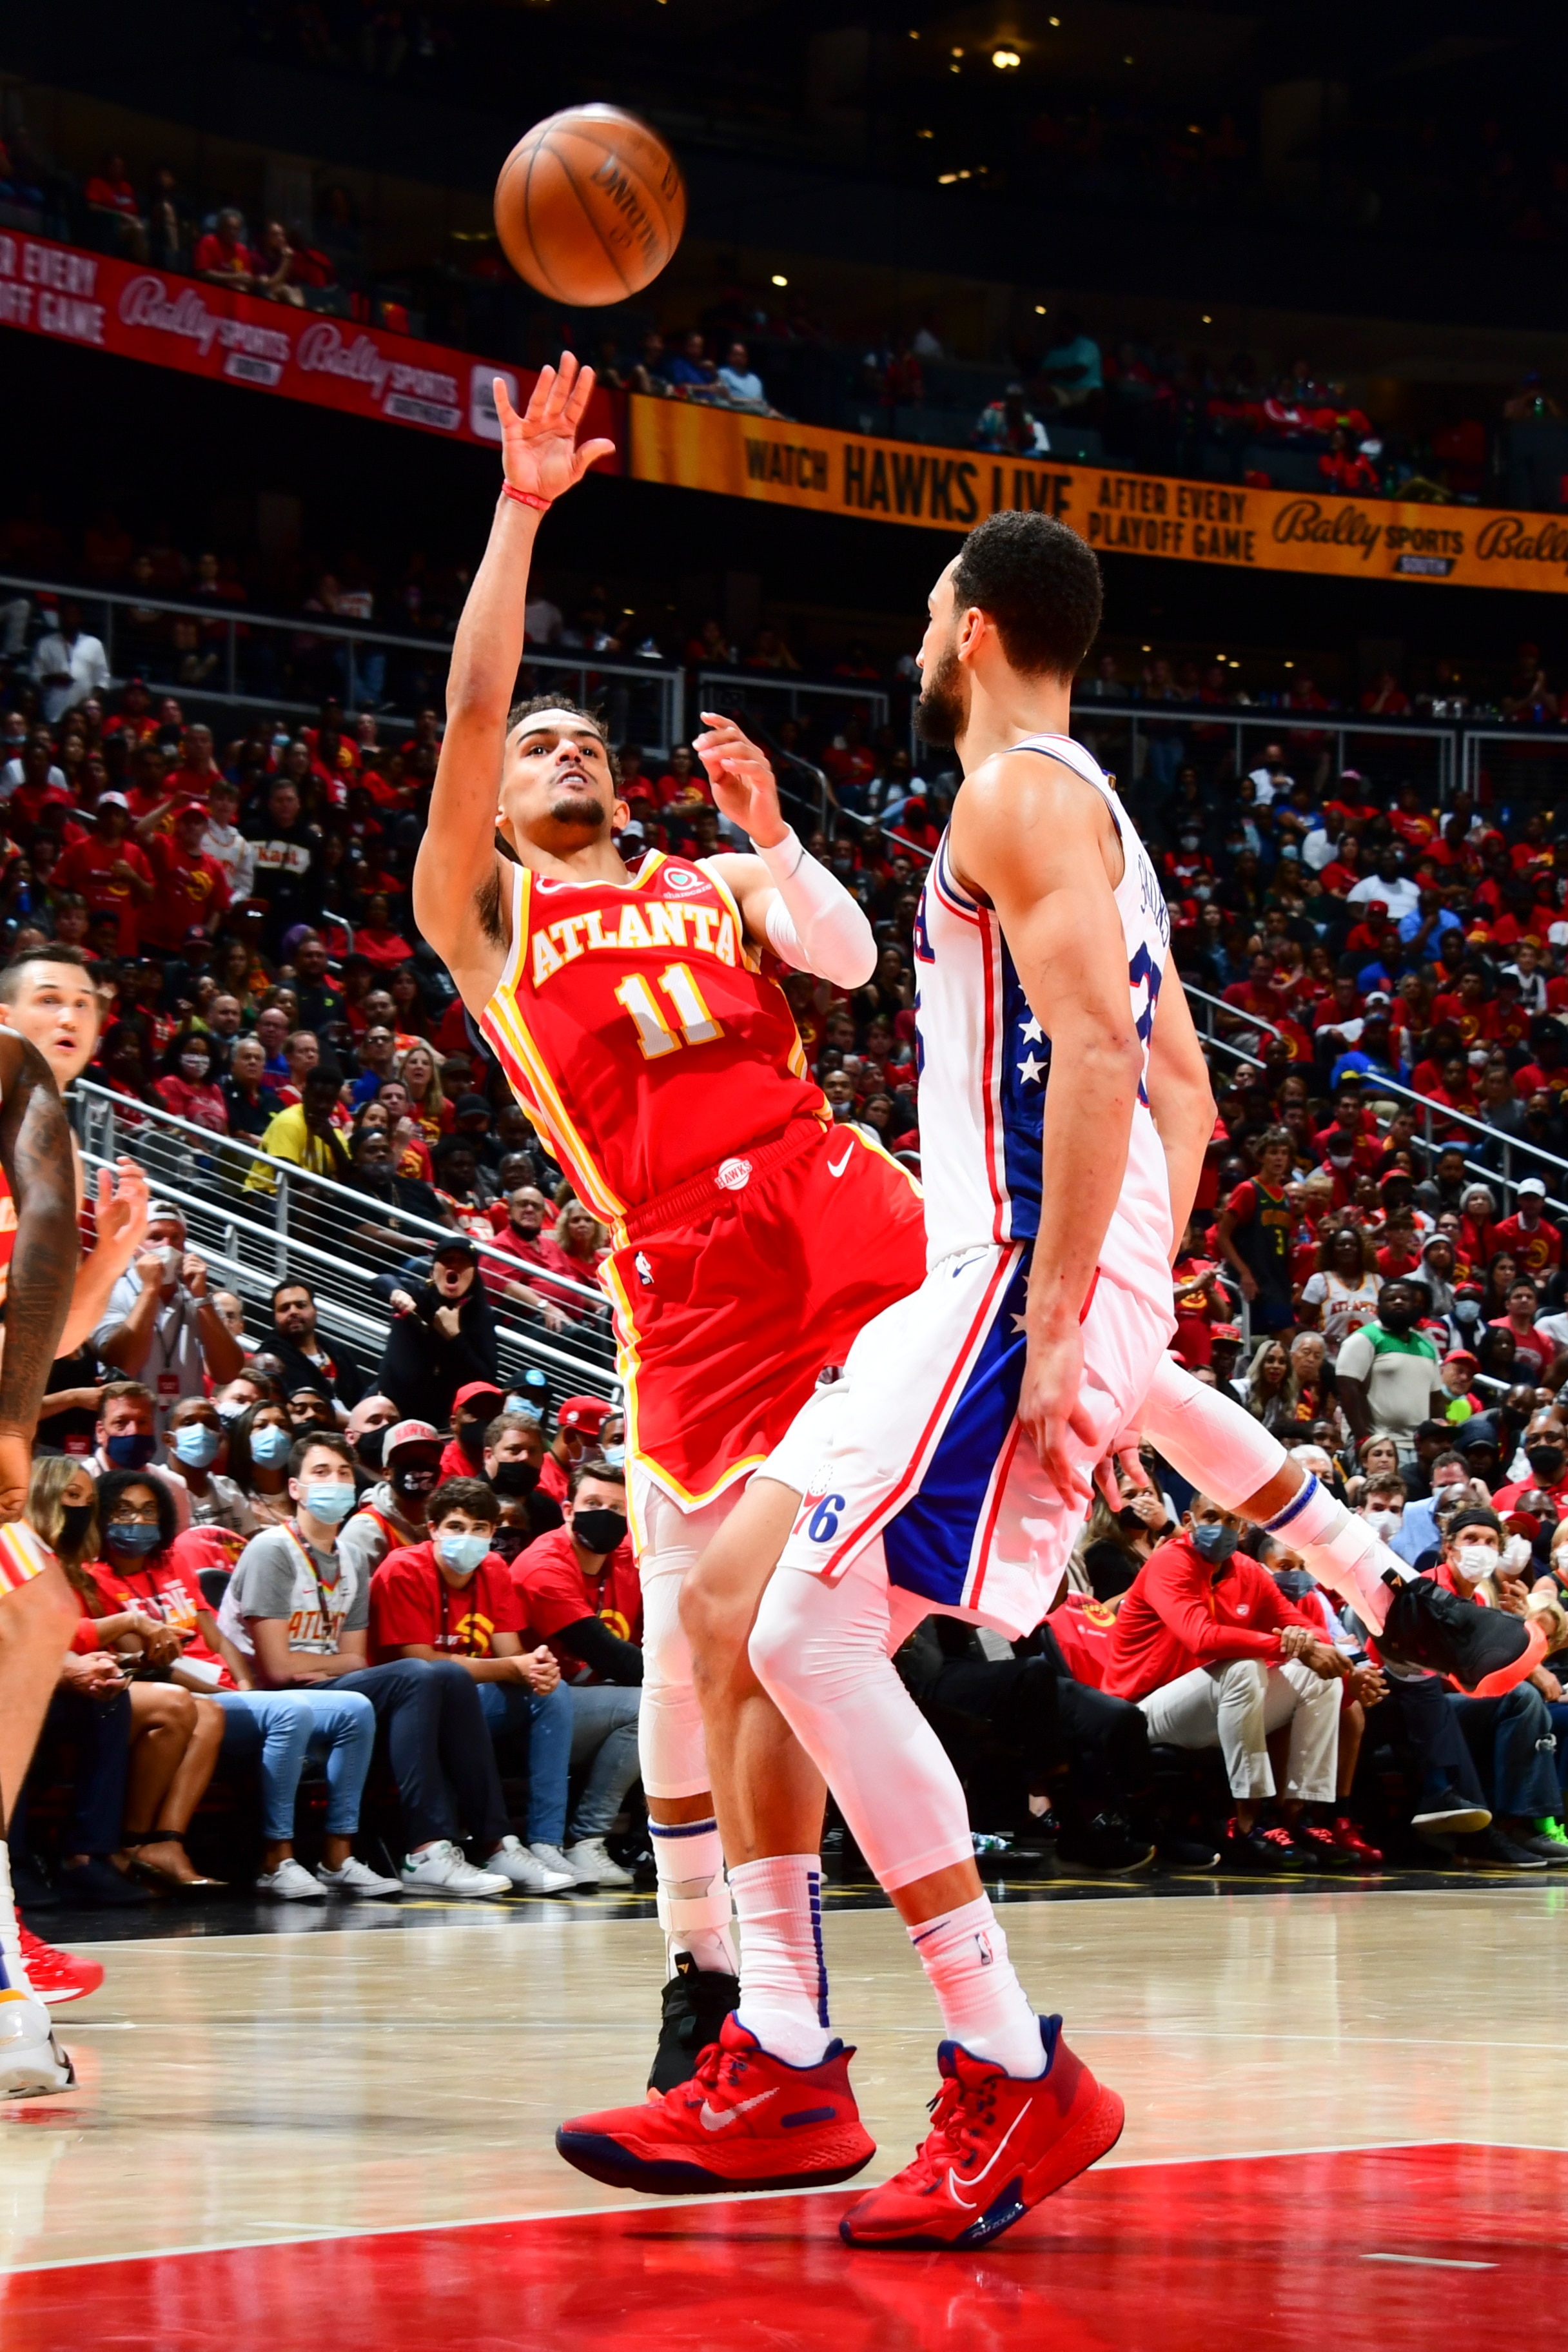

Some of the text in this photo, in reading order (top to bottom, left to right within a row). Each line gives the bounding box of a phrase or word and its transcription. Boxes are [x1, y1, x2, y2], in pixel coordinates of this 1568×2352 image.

[23, 242, 98, 299] EVERY
[39, 290, 106, 346] GAME
[119, 277, 220, 357] Bally
[297, 322, 388, 400] Bally
[745, 437, 828, 492] WATCH
[843, 444, 979, 523] HAWKS
[1098, 476, 1247, 524] AFTER EVERY
[1088, 512, 1255, 562] PLAYOFF GAME
[1273, 498, 1464, 560] Bally SPORTS
[1475, 516, 1568, 576] Ball
[663, 883, 712, 899] sharecare
[532, 901, 736, 989] ATLANTA
[614, 961, 725, 1061] 11
[714, 1160, 752, 1190] HAWKS
